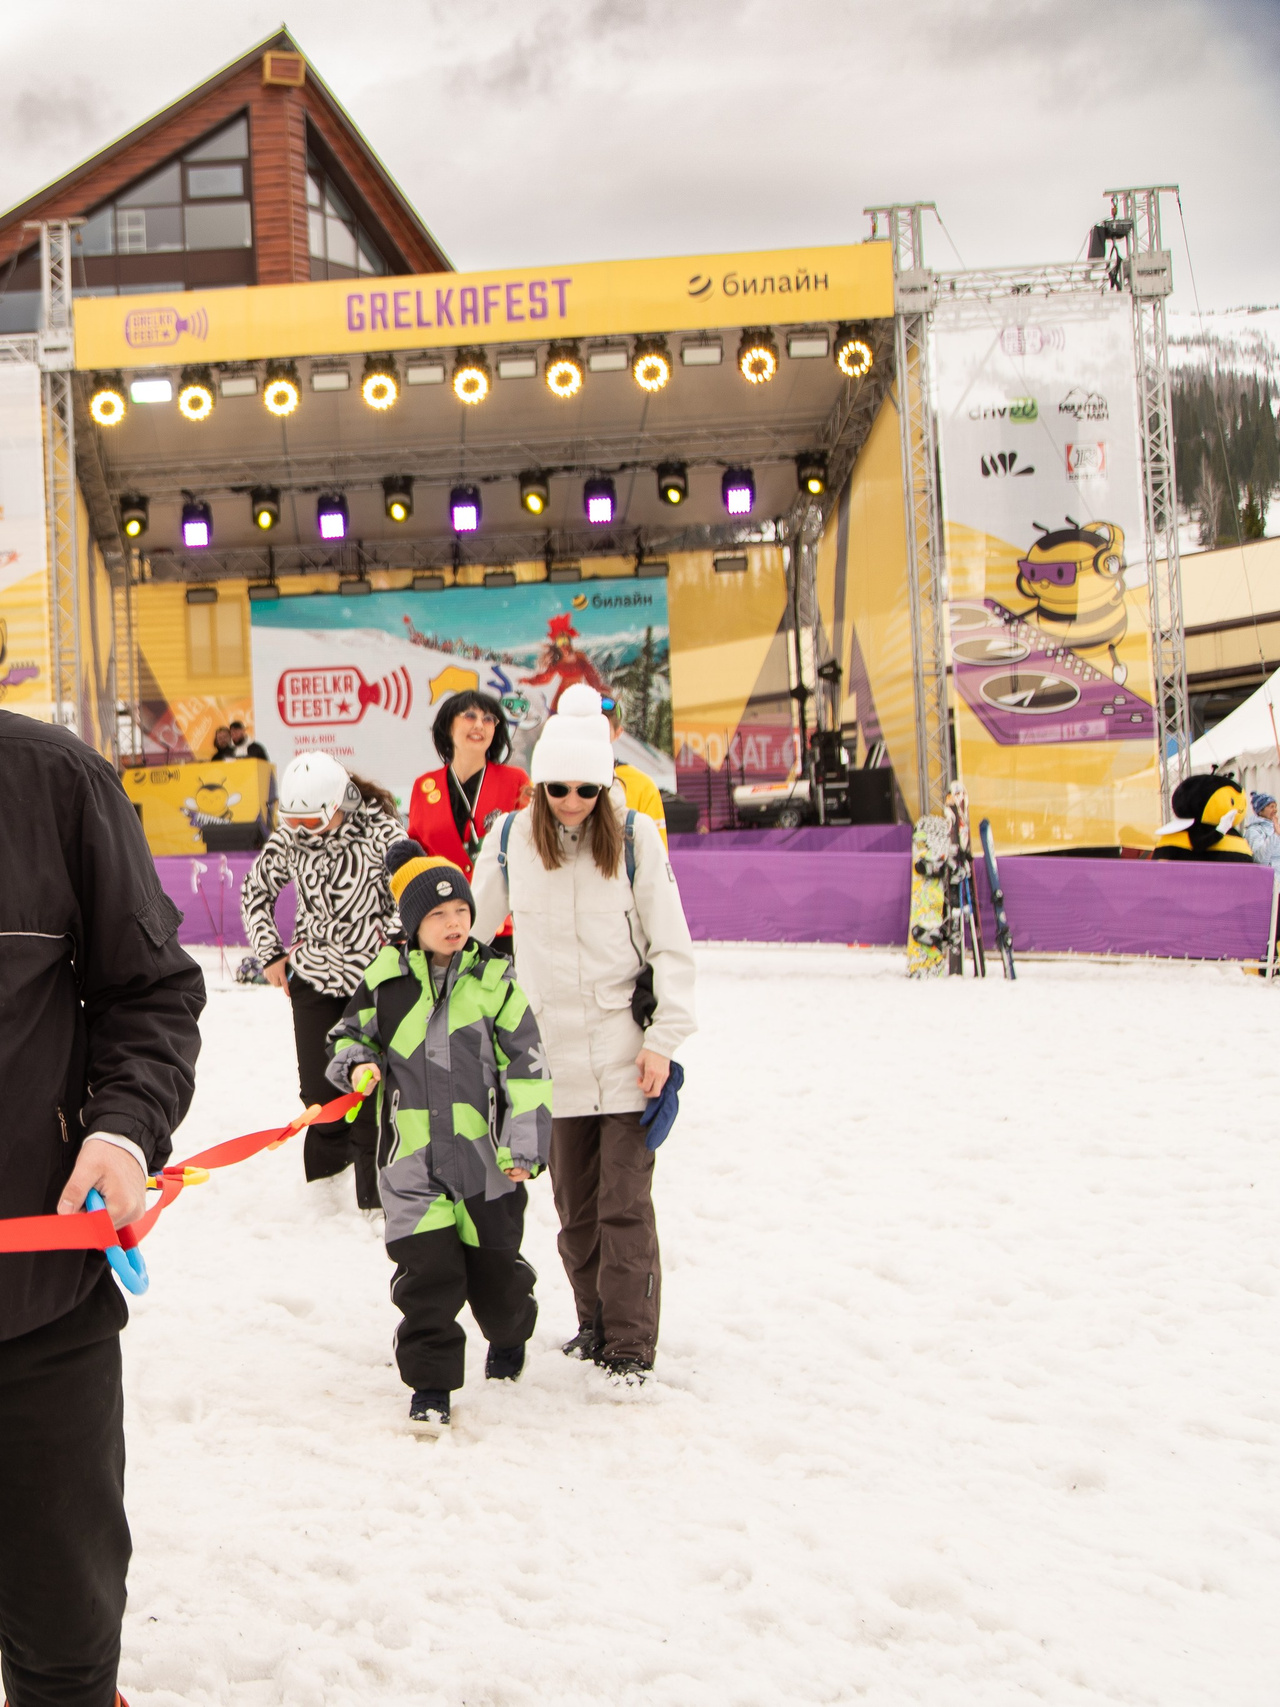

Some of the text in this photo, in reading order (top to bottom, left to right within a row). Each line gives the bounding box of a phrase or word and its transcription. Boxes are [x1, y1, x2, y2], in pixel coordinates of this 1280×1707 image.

[721, 269, 831, 298] билайн
[346, 277, 573, 332] GRELKAFEST
[592, 592, 653, 609] билайн
[290, 675, 353, 696] GRELKA
[291, 698, 334, 718] FEST
